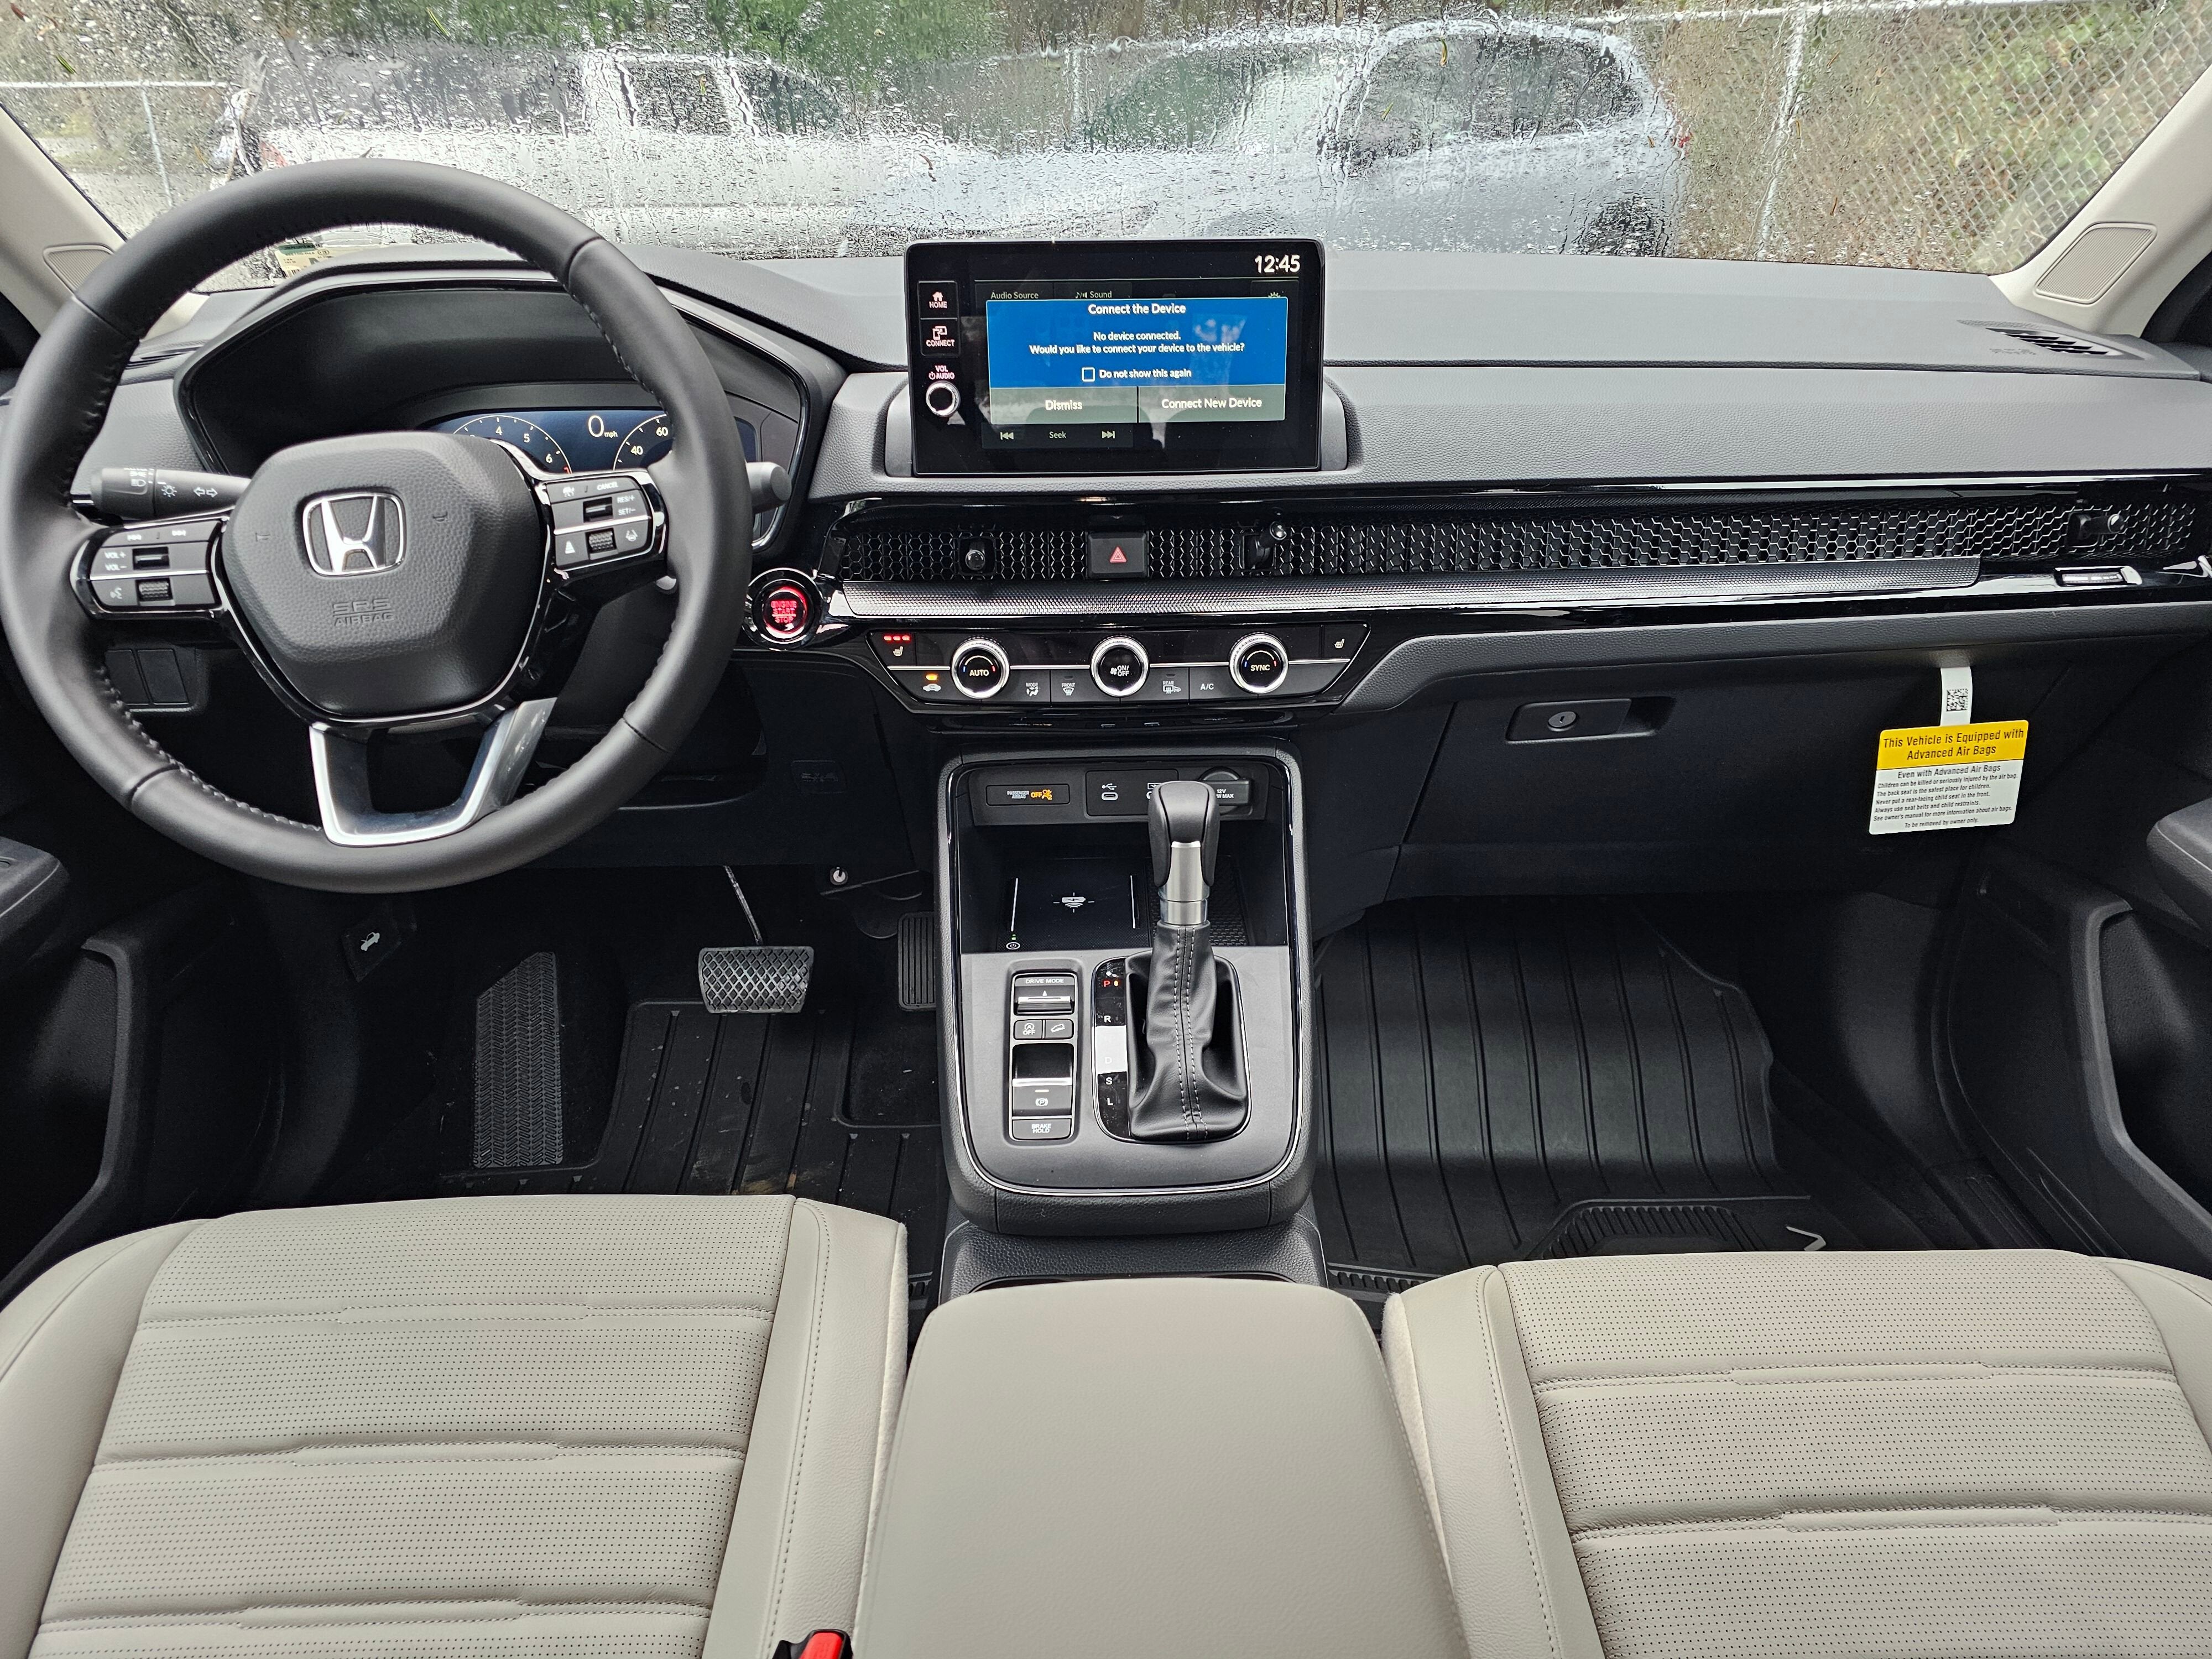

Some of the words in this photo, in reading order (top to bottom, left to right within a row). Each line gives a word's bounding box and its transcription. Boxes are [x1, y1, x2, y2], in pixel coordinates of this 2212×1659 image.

[1255, 255, 1300, 273] 12:45
[1088, 304, 1131, 314] Connect
[1133, 304, 1150, 314] the
[1152, 304, 1186, 314] Device
[1109, 332, 1134, 341] device
[1136, 331, 1181, 340] connected.
[1030, 346, 1055, 354] Would
[1057, 347, 1074, 356] you
[1077, 345, 1091, 354] like
[1103, 346, 1135, 354] connect
[1137, 346, 1156, 356] your
[1159, 344, 1185, 353] device
[1197, 344, 1210, 353] the
[1212, 343, 1244, 352] vehicle?
[1099, 369, 1111, 378] Do
[1129, 369, 1151, 378] show
[1153, 369, 1168, 378] this
[1170, 369, 1192, 379] again
[1045, 400, 1083, 410] Dismiss
[1161, 398, 1201, 409] Connect
[1204, 397, 1227, 408] New
[1229, 397, 1262, 408] Device
[495, 427, 502, 436] 4
[588, 415, 605, 438] 0
[604, 430, 618, 439] mph
[656, 427, 669, 437] 60
[1049, 430, 1067, 440] Seek
[524, 434, 530, 443] 5
[630, 445, 644, 456] 40
[546, 453, 553, 463] 6
[597, 482, 619, 491] CANCEL
[333, 598, 391, 613] SRS
[334, 613, 393, 627] AIRBAG
[1884, 738, 1903, 748] This
[1907, 735, 1942, 746] Vehicle
[1945, 734, 1953, 743] is
[1957, 731, 2000, 743] Equipped
[2004, 729, 2023, 739] with
[1907, 748, 1953, 760] Advanced
[1957, 747, 1969, 756] Air
[1974, 745, 1996, 755] Bags
[1917, 769, 1932, 777] with
[1934, 766, 1969, 776] Advanced
[1984, 764, 2001, 773] Bags
